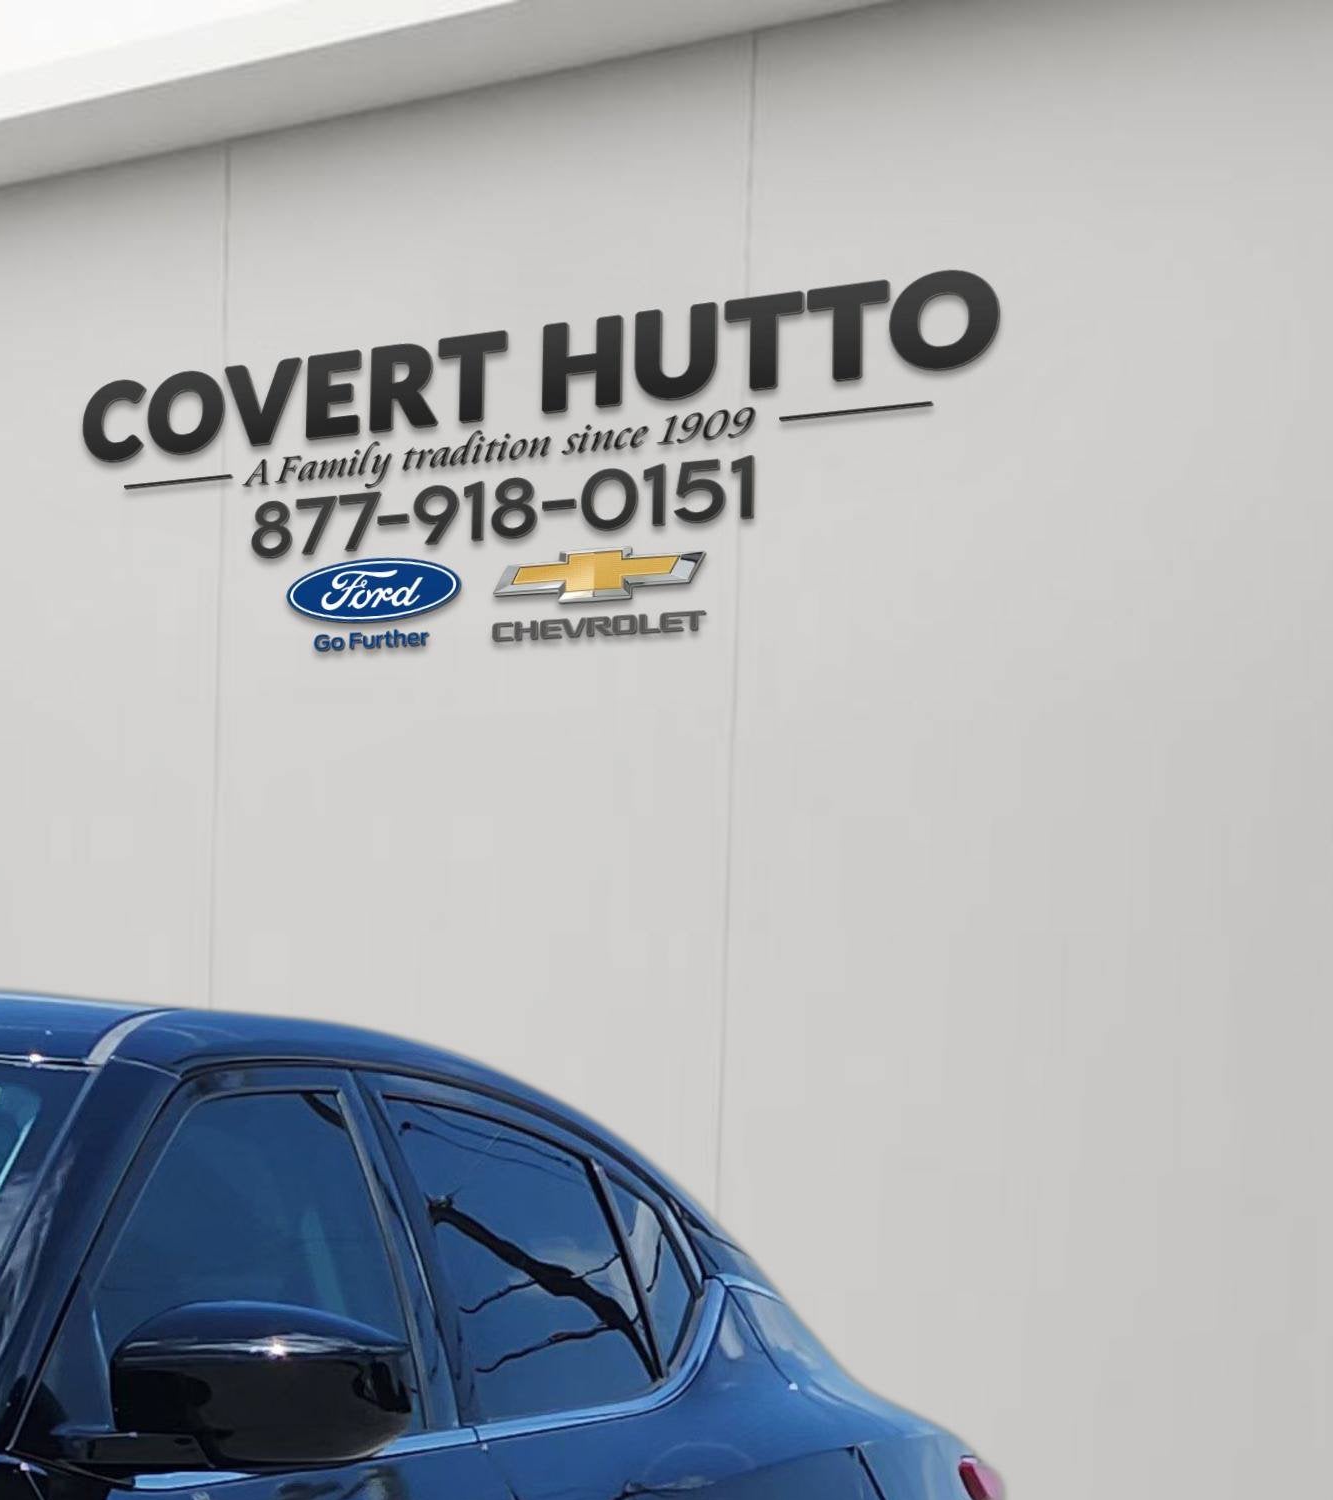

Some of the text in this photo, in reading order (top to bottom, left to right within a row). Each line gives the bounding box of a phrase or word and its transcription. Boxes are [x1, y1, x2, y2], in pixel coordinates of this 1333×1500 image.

[82, 269, 1001, 464] COVERT HUTTO
[241, 406, 757, 490] A Family tradition since 1909
[250, 453, 756, 560] 877-918-0151
[319, 567, 425, 611] Ford
[312, 628, 431, 653] Go Further
[490, 609, 707, 644] CHEVROLET
